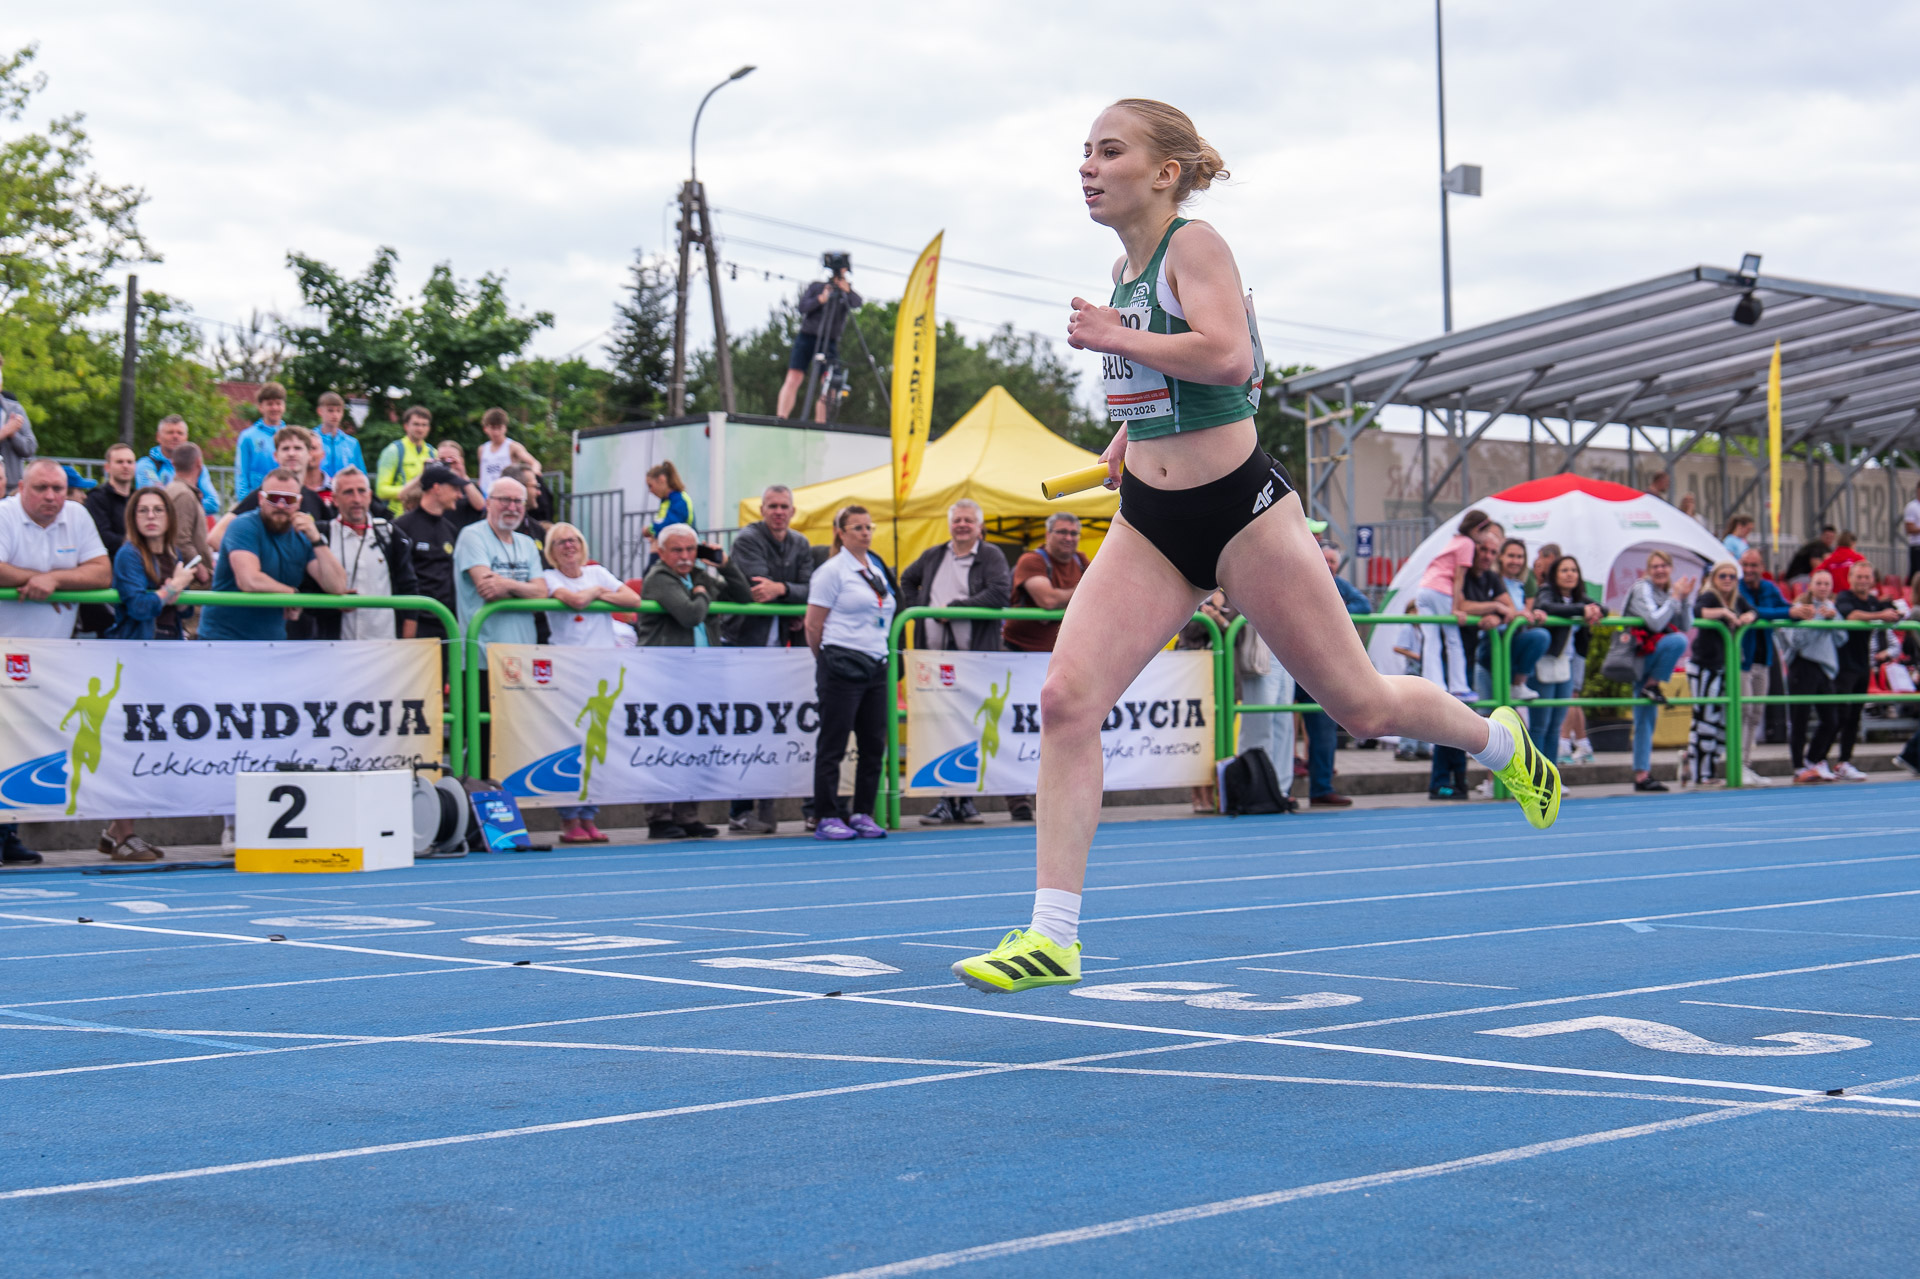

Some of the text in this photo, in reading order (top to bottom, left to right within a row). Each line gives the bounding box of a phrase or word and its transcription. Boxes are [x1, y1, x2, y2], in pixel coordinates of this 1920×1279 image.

[1134, 404, 1156, 415] 2026
[123, 700, 431, 742] KONDYCJA
[623, 701, 821, 737] KONDYC
[1012, 698, 1206, 734] KDYCJA
[267, 784, 308, 839] 2
[460, 932, 682, 951] 5
[690, 953, 904, 977] 4
[1070, 981, 1364, 1011] 3
[1474, 1015, 1874, 1057] 2
